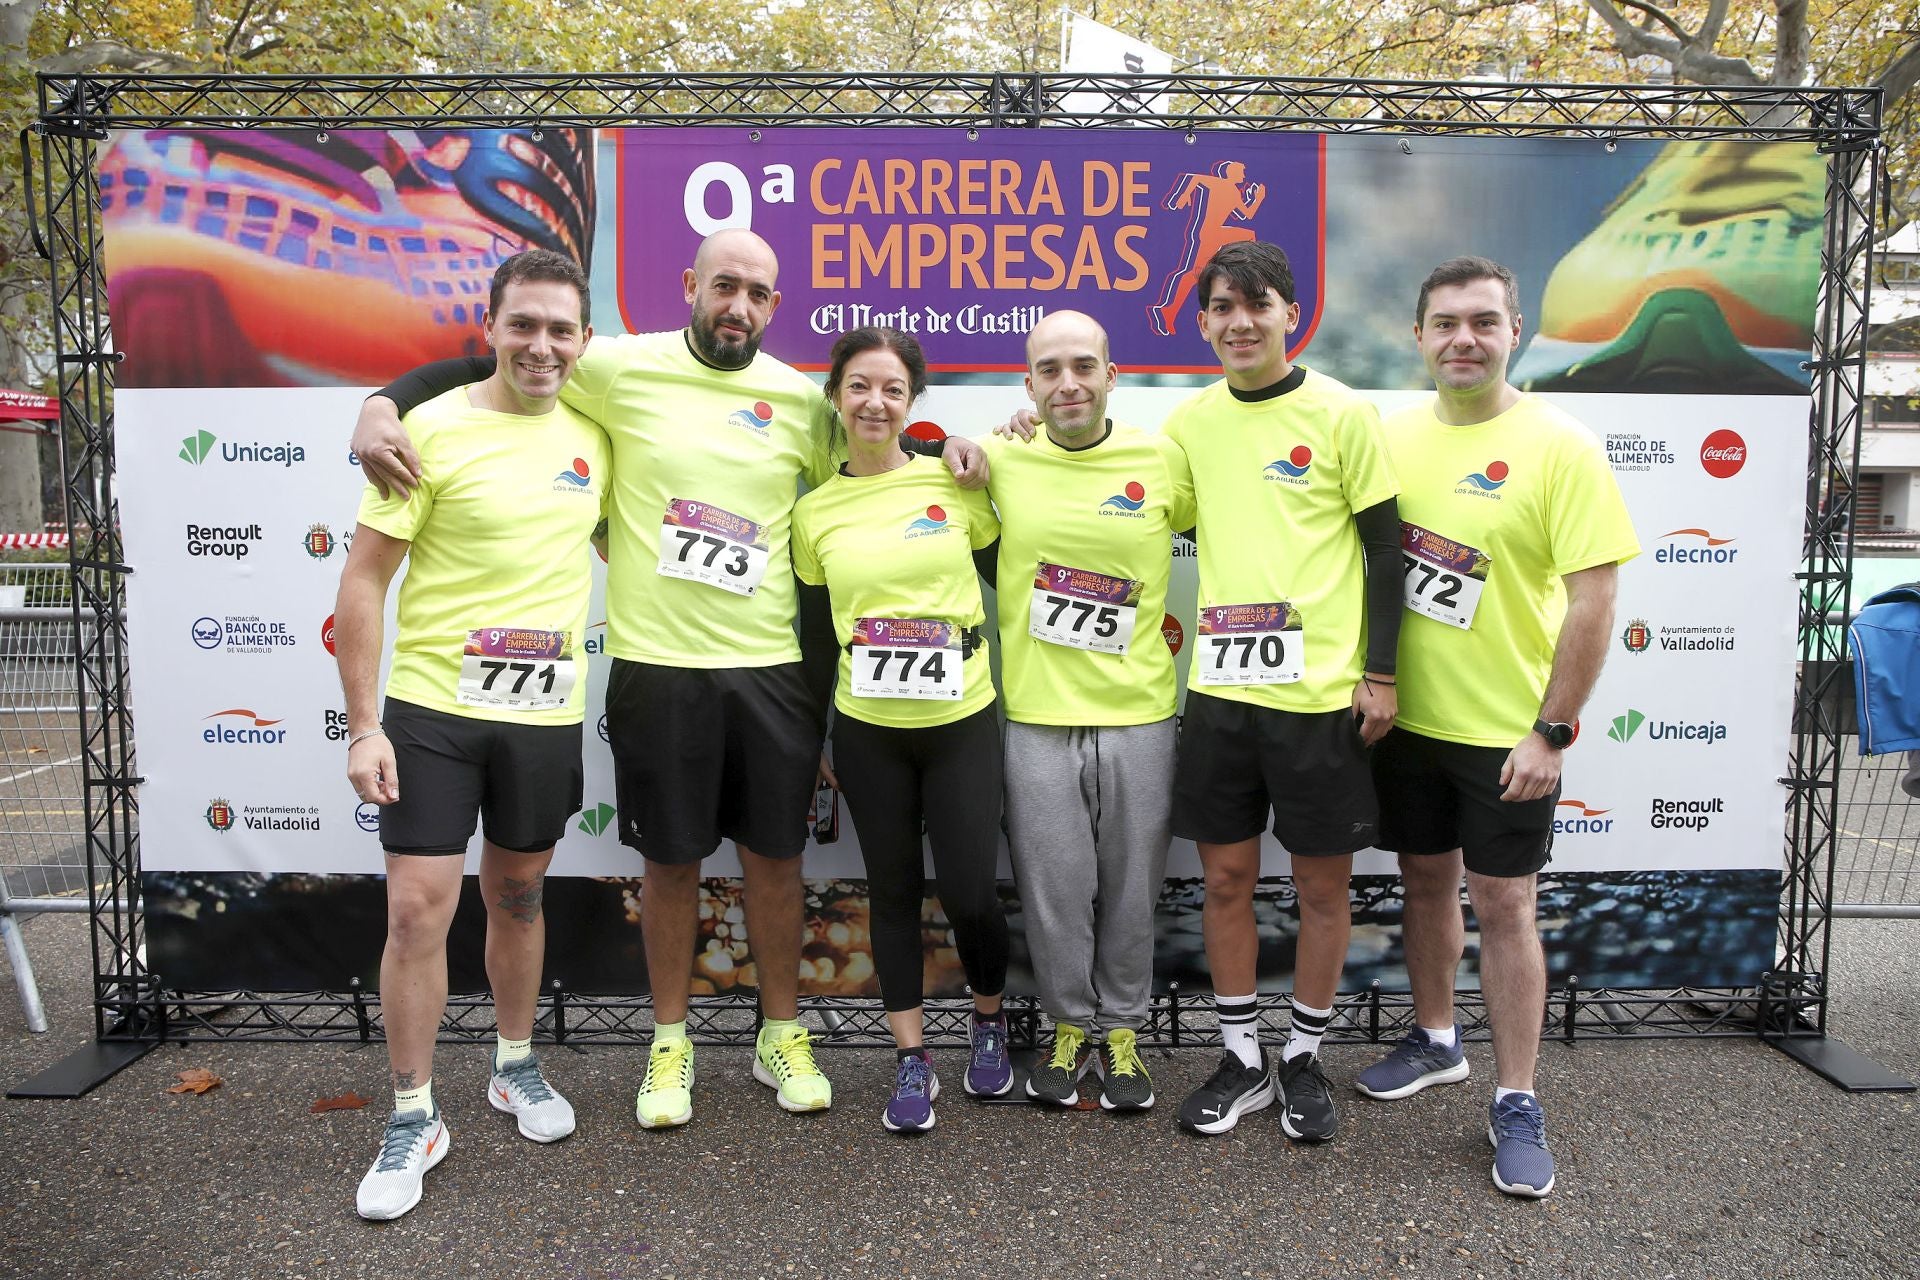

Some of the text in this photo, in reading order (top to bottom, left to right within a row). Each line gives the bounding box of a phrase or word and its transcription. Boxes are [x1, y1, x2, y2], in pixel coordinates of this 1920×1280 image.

[809, 158, 1065, 216] CARRERA
[1083, 160, 1151, 217] DE
[811, 222, 1150, 292] EMPRESAS
[810, 303, 1045, 335] El Norte de Castill
[1606, 432, 1641, 440] FUNDACIÓN
[1606, 440, 1666, 452] BANCO DE
[221, 441, 306, 468] Unicaja
[1608, 452, 1675, 464] ALIMENTOS
[1454, 487, 1467, 495] LOS
[701, 512, 739, 533] EMPRESAS
[1114, 511, 1146, 519] ABUELOS
[186, 524, 263, 541] Renault
[187, 540, 249, 561] Group
[675, 529, 750, 577] 773
[1421, 539, 1455, 560] EMPRESAS
[1655, 543, 1738, 563] elecnor
[1070, 578, 1110, 594] EMPRESAS
[1072, 571, 1101, 585] CARRERA
[1102, 577, 1112, 586] DE
[1046, 594, 1119, 638] 775
[1256, 606, 1266, 615] DE
[225, 615, 260, 623] FUNDACIÓN
[921, 622, 930, 630] DE
[1227, 613, 1266, 624] EMPRESAS
[225, 622, 286, 634] BANCO DE
[889, 628, 930, 638] EMPRESAS
[1660, 625, 1735, 636] Ayuntamiento de
[226, 634, 296, 646] ALIMENTOS
[506, 631, 538, 641] CARRERA
[538, 633, 547, 641] DE
[1660, 636, 1735, 651] Valladolid
[505, 640, 547, 650] EMPRESAS
[1211, 635, 1285, 669] 770
[868, 649, 946, 684] 774
[480, 660, 556, 694] 771
[203, 723, 287, 744] elecnor
[1649, 720, 1727, 745] Unicaja
[243, 805, 319, 816] Ayuntamiento de
[1651, 798, 1724, 813] Renault
[244, 816, 321, 831] Valladolid
[1553, 819, 1614, 834] ecnor
[1650, 813, 1710, 833] Group
